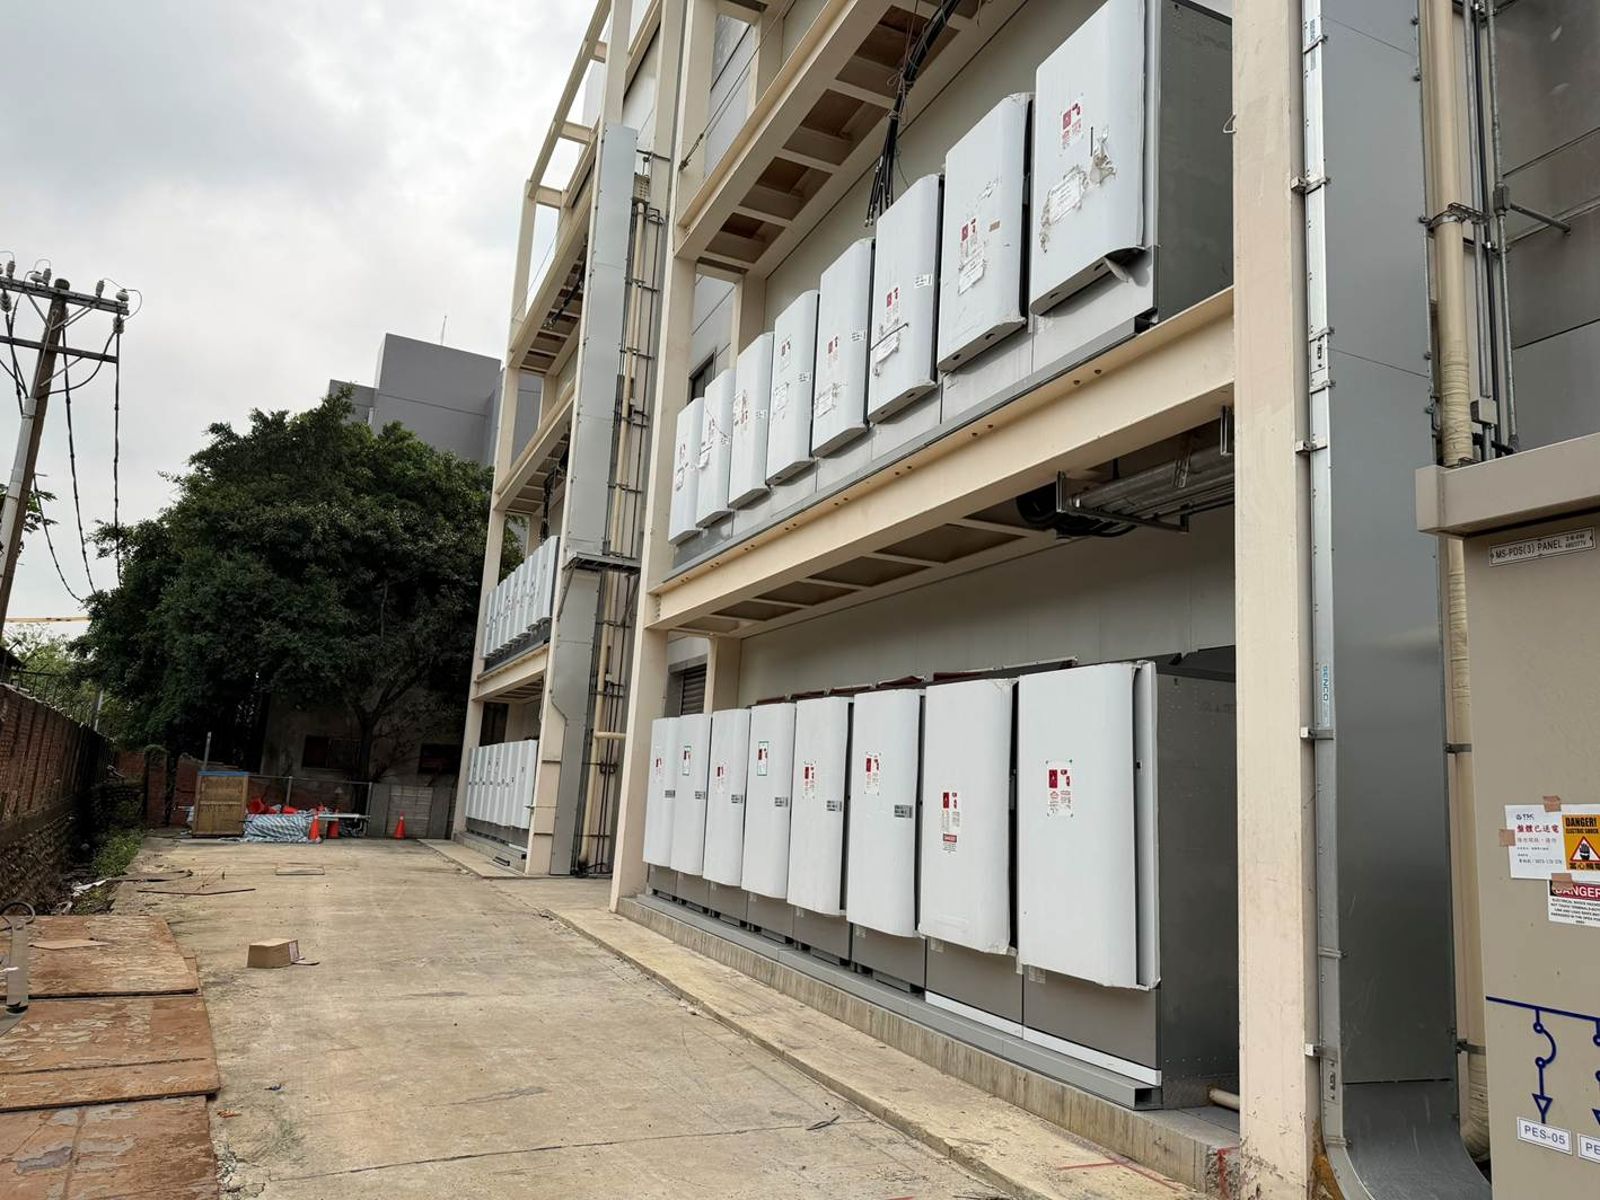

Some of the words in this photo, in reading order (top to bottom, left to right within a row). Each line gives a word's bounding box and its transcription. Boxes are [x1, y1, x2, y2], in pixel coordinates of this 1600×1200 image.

[1537, 540, 1562, 551] PANEL
[1565, 817, 1597, 827] DANGER!
[1524, 1125, 1566, 1145] PES-05
